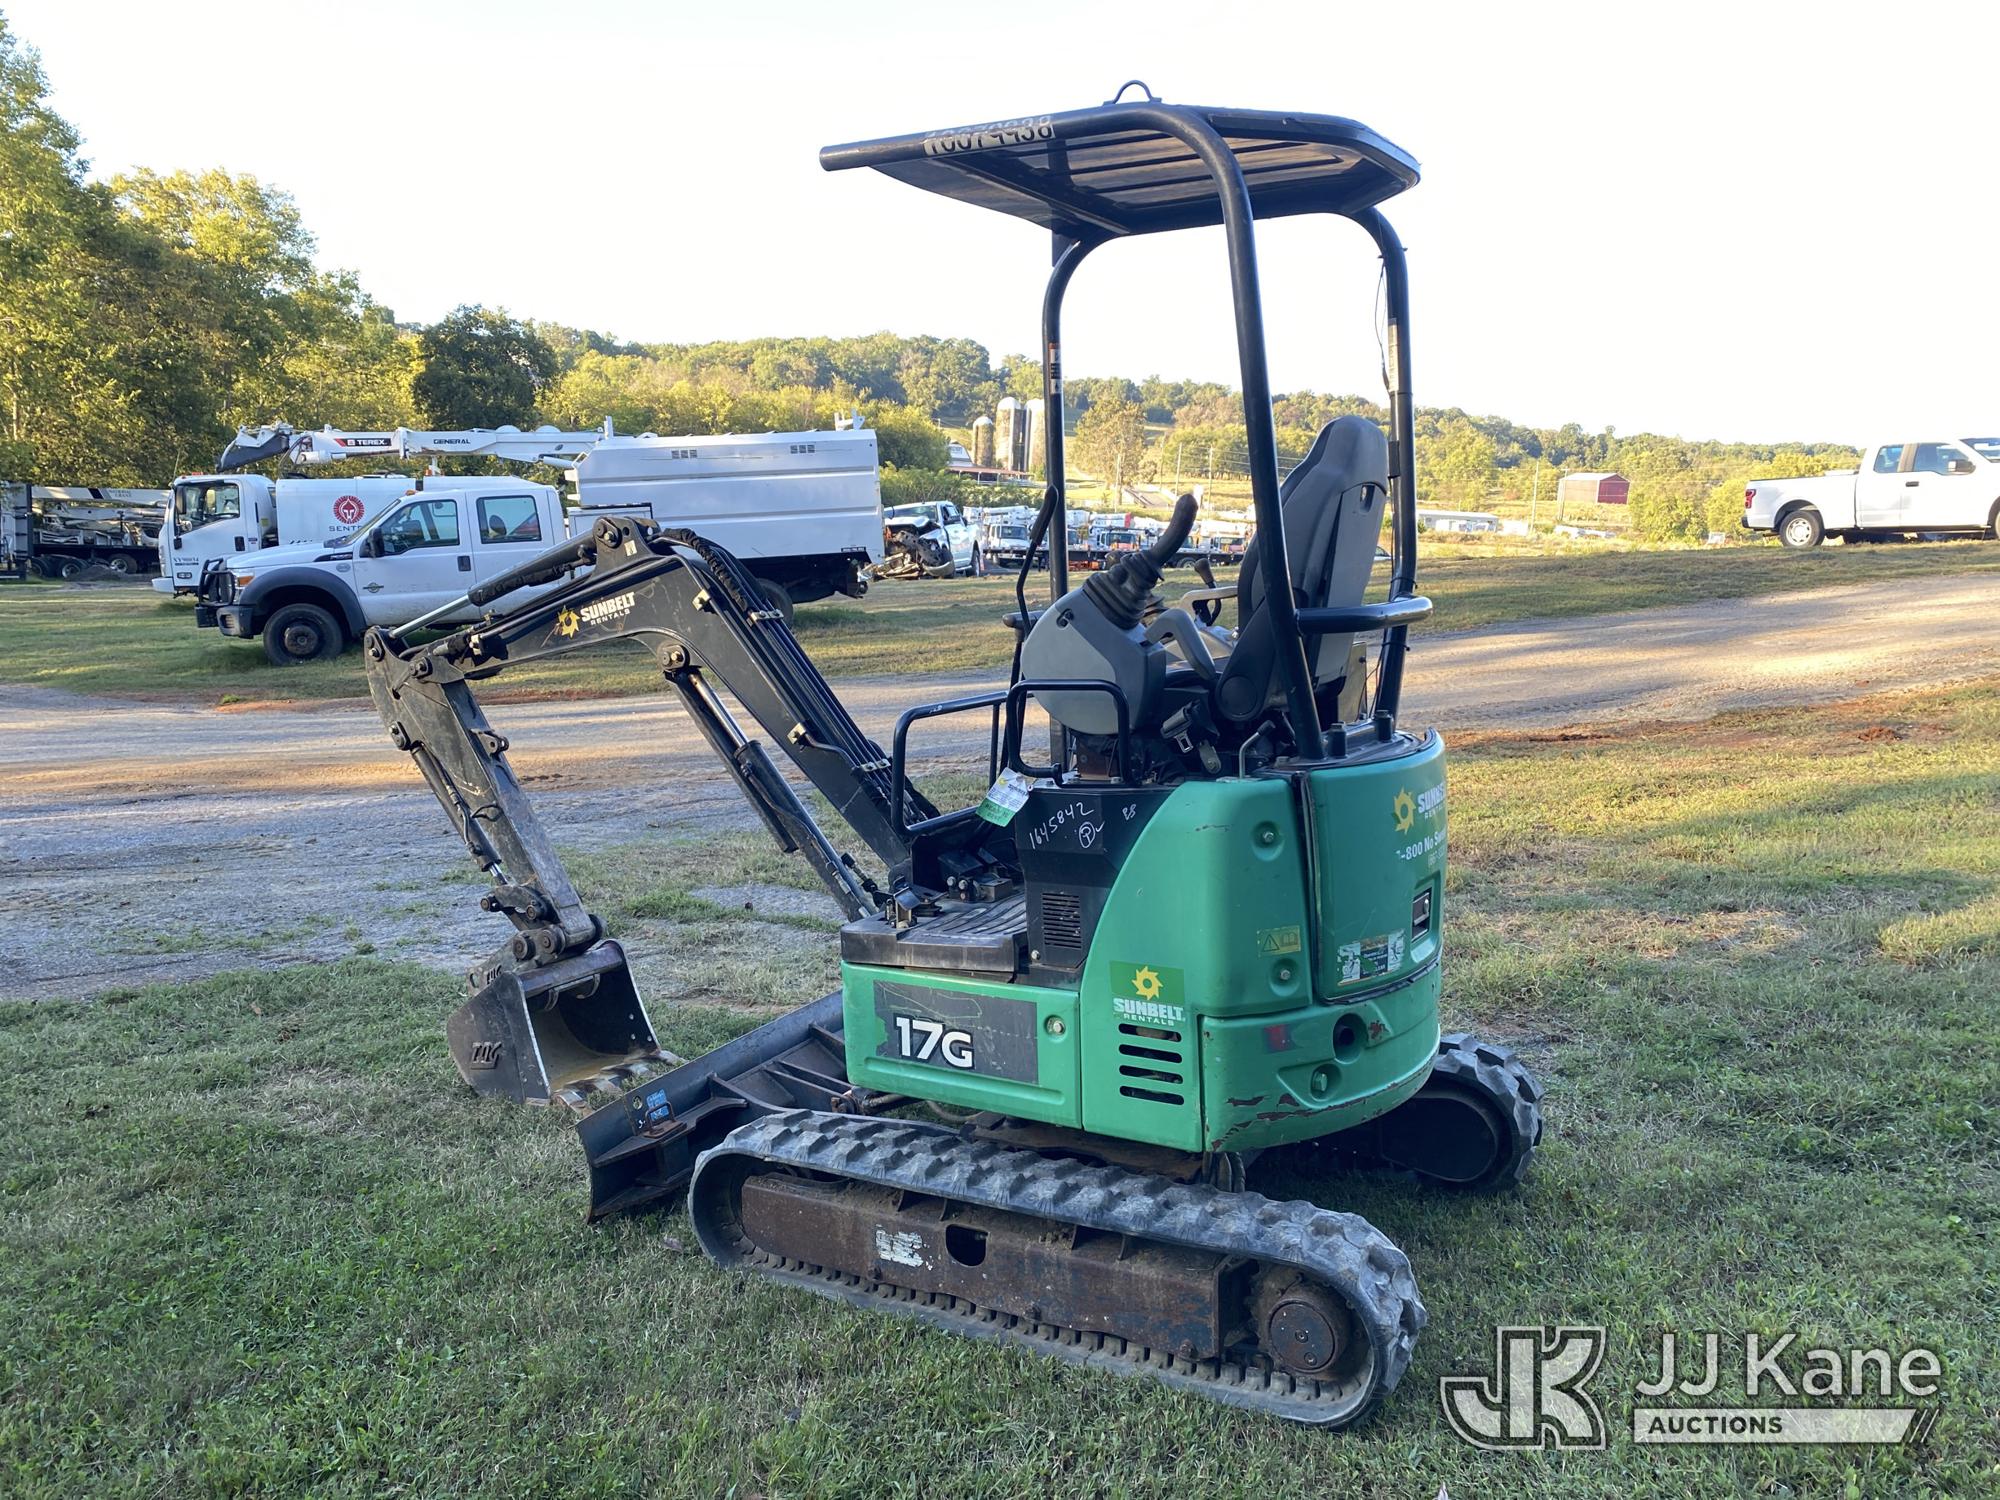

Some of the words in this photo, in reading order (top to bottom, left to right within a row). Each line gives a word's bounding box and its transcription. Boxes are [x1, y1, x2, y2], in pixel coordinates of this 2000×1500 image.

[357, 438, 385, 446] TEREX
[580, 591, 635, 622] SUNBELT
[590, 608, 630, 625] RENTALS
[1029, 802, 1094, 849] 1645842
[1424, 835, 1434, 853] No
[1113, 997, 1184, 1021] SUNBELT
[1123, 1013, 1175, 1027] RENTALS
[896, 1016, 973, 1068] 17G
